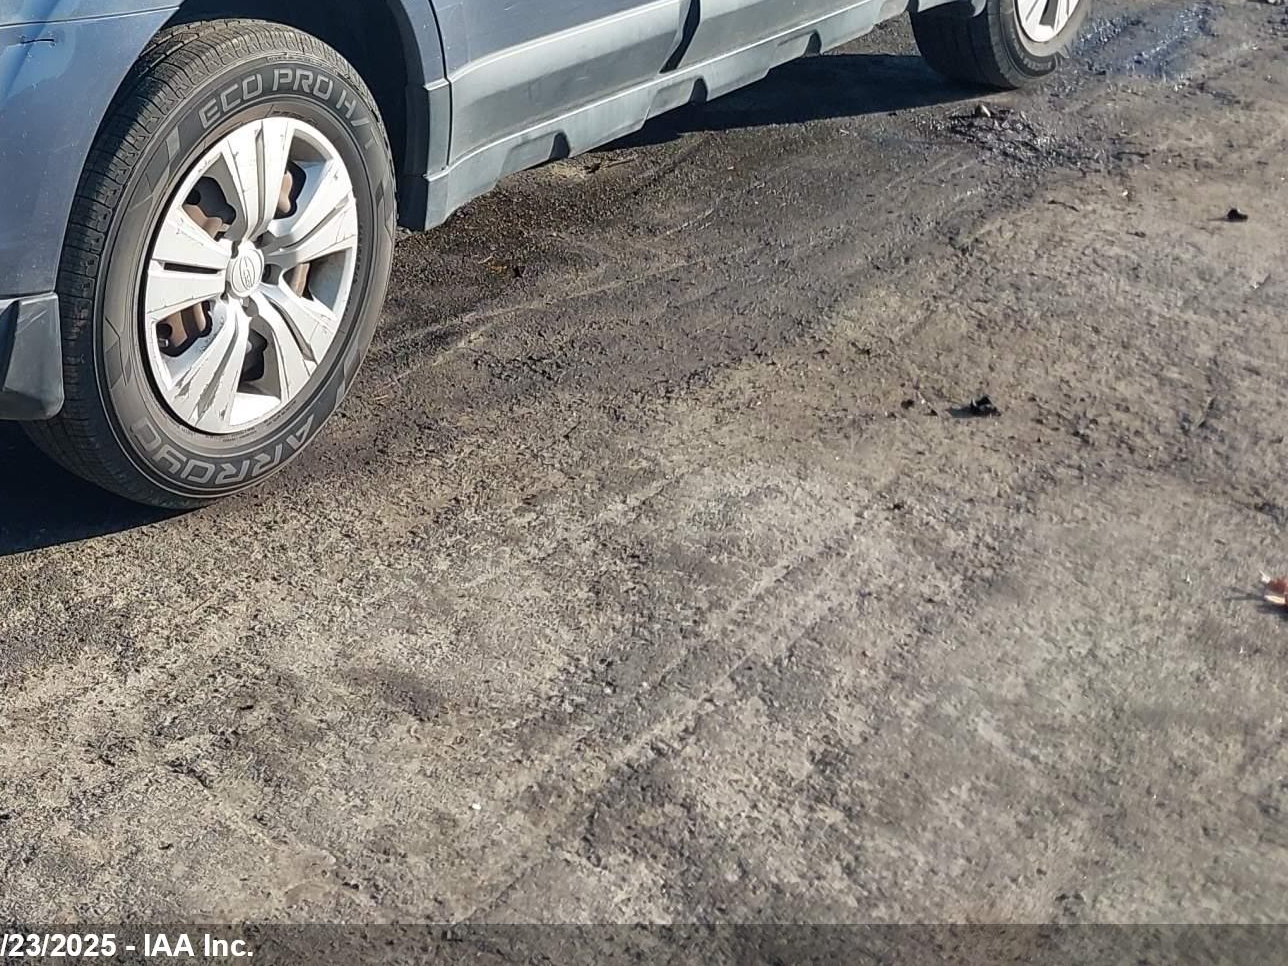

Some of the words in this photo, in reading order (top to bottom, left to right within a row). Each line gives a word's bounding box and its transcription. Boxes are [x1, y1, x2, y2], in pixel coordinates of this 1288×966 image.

[197, 73, 263, 130] ECO
[271, 67, 334, 98] PRO
[129, 414, 316, 484] ARROYO
